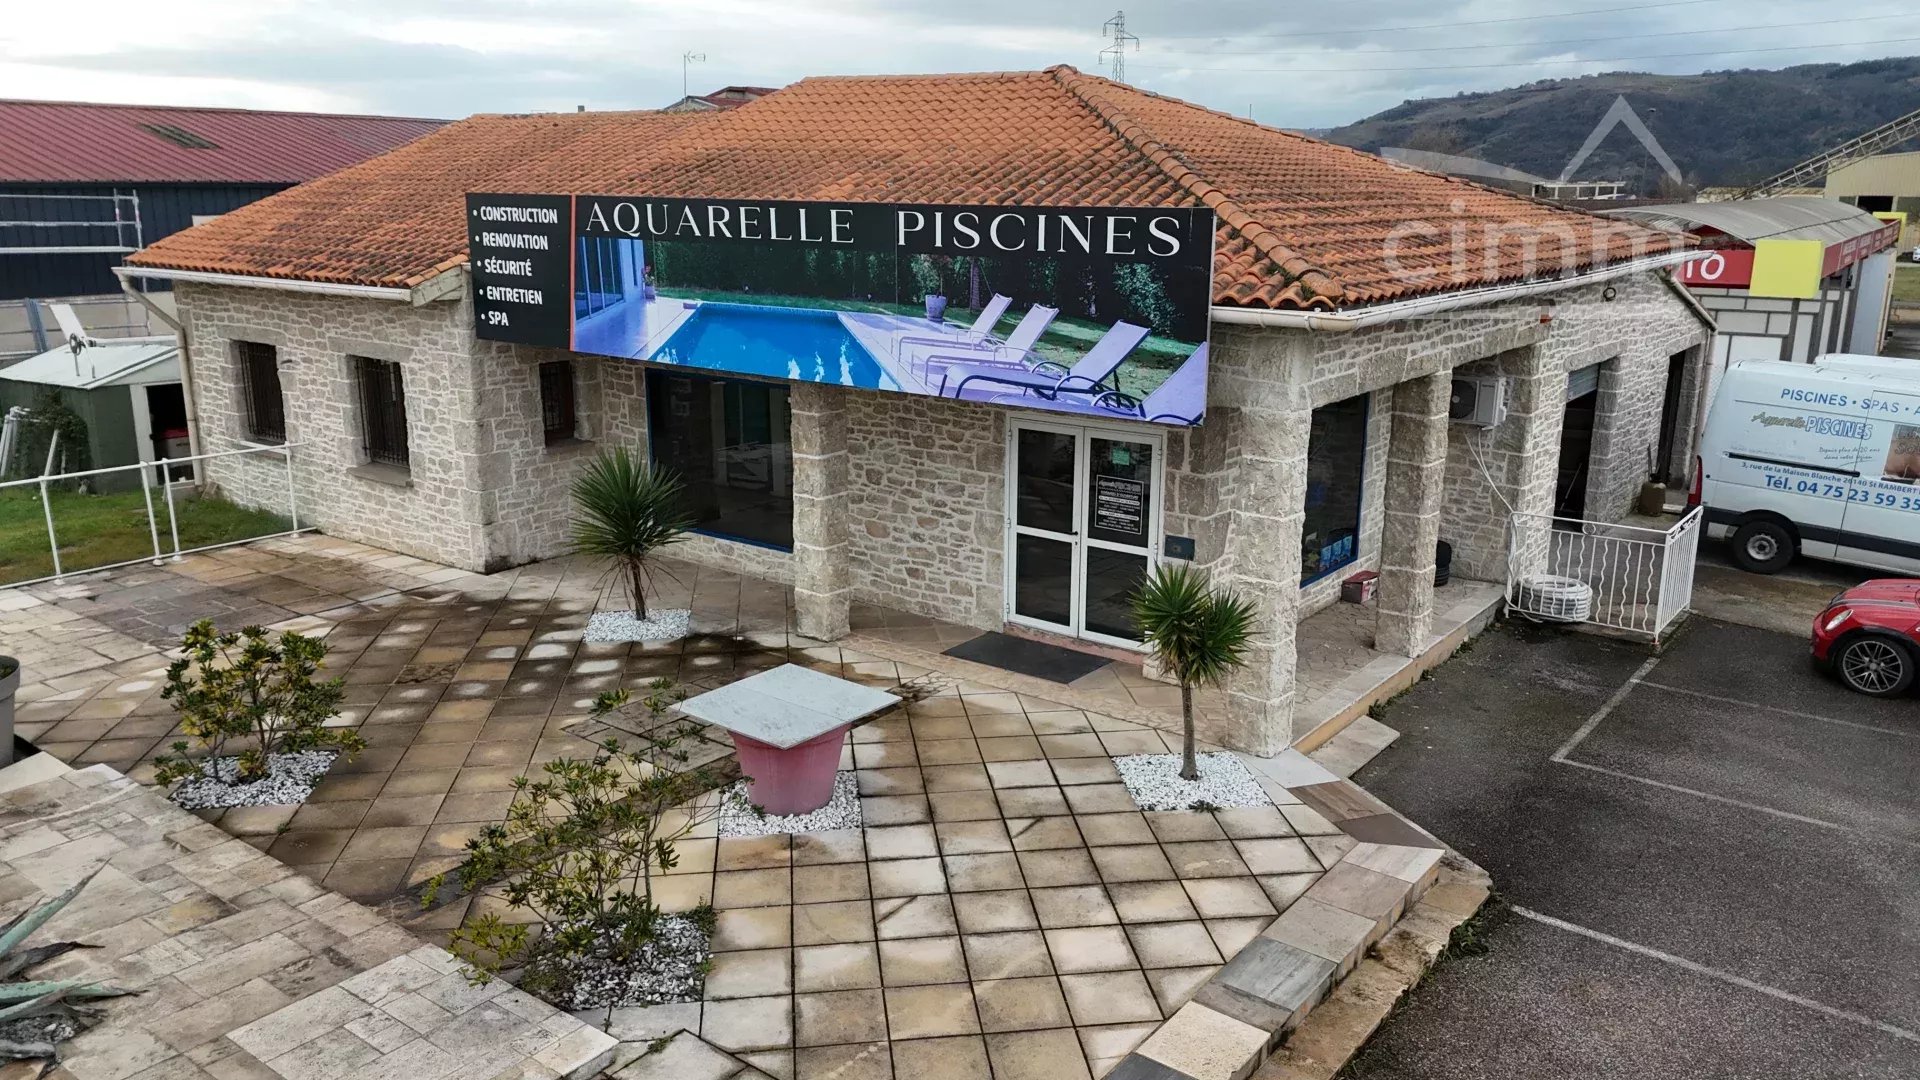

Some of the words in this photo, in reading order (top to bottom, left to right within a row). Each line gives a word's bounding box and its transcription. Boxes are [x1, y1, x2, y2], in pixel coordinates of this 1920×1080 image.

[480, 205, 559, 225] CONSTRUCTION
[585, 201, 855, 244] AQUARELLE
[897, 210, 1181, 257] PISCINES
[482, 232, 549, 251] RENOVATION
[484, 255, 533, 277] SÉCURITÉ
[486, 285, 543, 305] ENTRETIEN
[488, 310, 510, 327] SPA
[1781, 388, 1848, 406] PISCINES
[1861, 398, 1900, 413] SPAS
[1805, 415, 1874, 441] PISCINES
[1782, 467, 1810, 478] Maison
[1811, 471, 1842, 483] Blanche
[1879, 482, 1918, 494] RAMBERT
[1765, 474, 1793, 491] Tél.
[1796, 480, 1818, 494] 04
[1822, 484, 1844, 498] 75
[1847, 488, 1870, 503] 23
[1873, 492, 1897, 507] 59
[1900, 496, 1920, 511] 35
